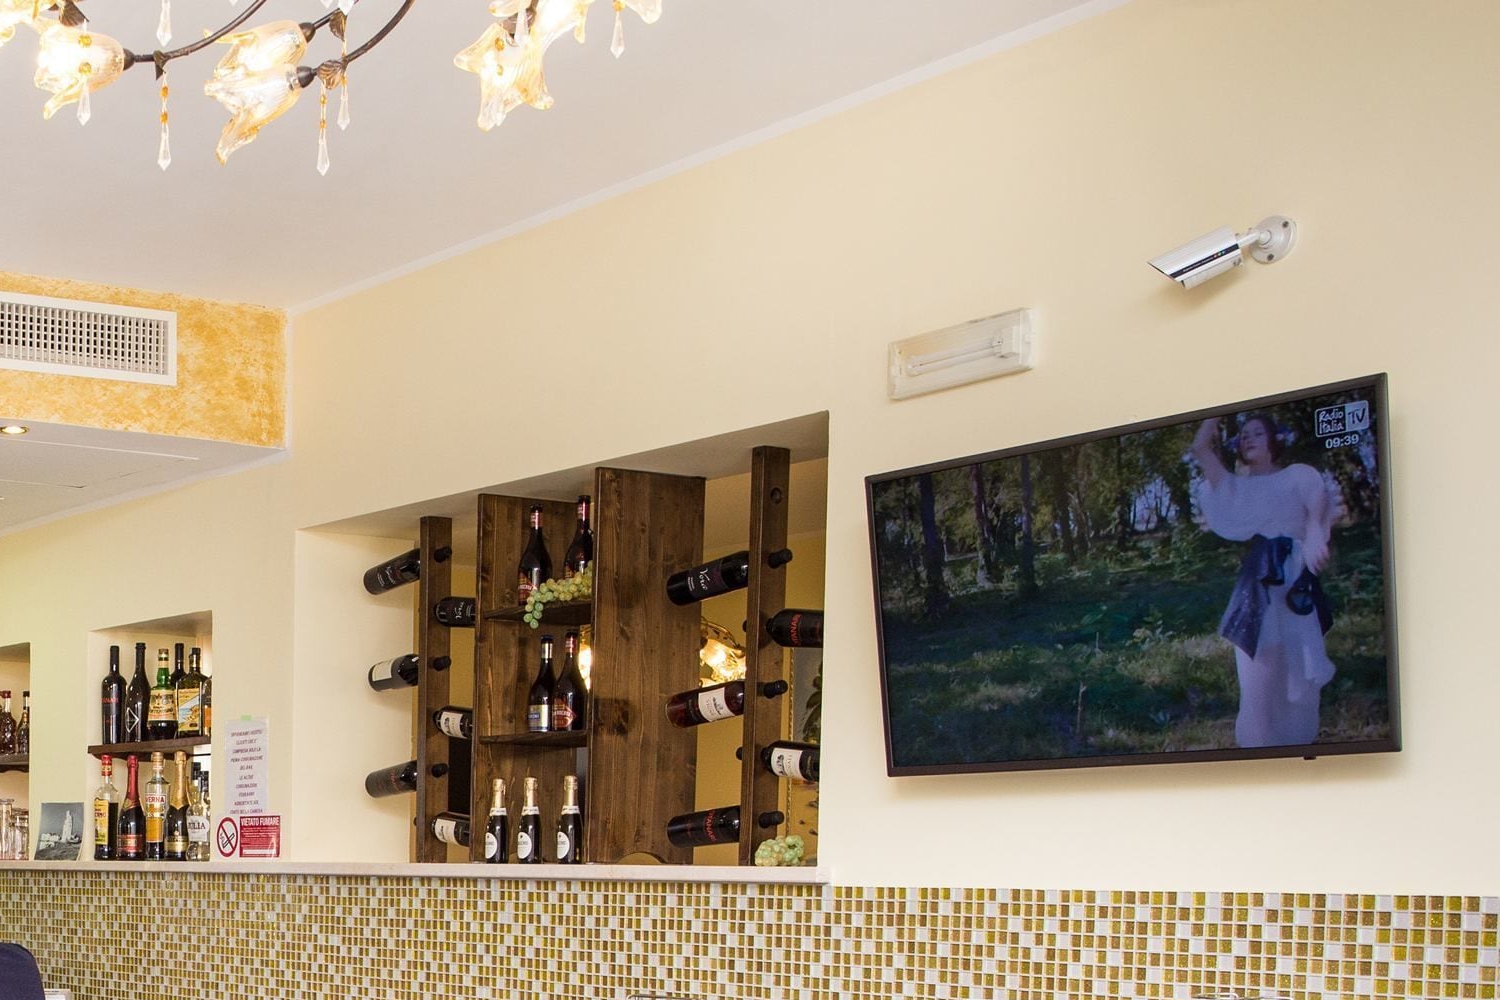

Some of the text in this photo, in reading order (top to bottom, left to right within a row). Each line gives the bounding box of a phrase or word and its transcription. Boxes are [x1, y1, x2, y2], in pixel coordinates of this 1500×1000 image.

[1319, 408, 1344, 422] Radio
[1348, 408, 1366, 424] TV
[1319, 420, 1345, 434] Italia
[1325, 434, 1360, 449] 09:39
[241, 817, 280, 826] VIETATO FUMARE
